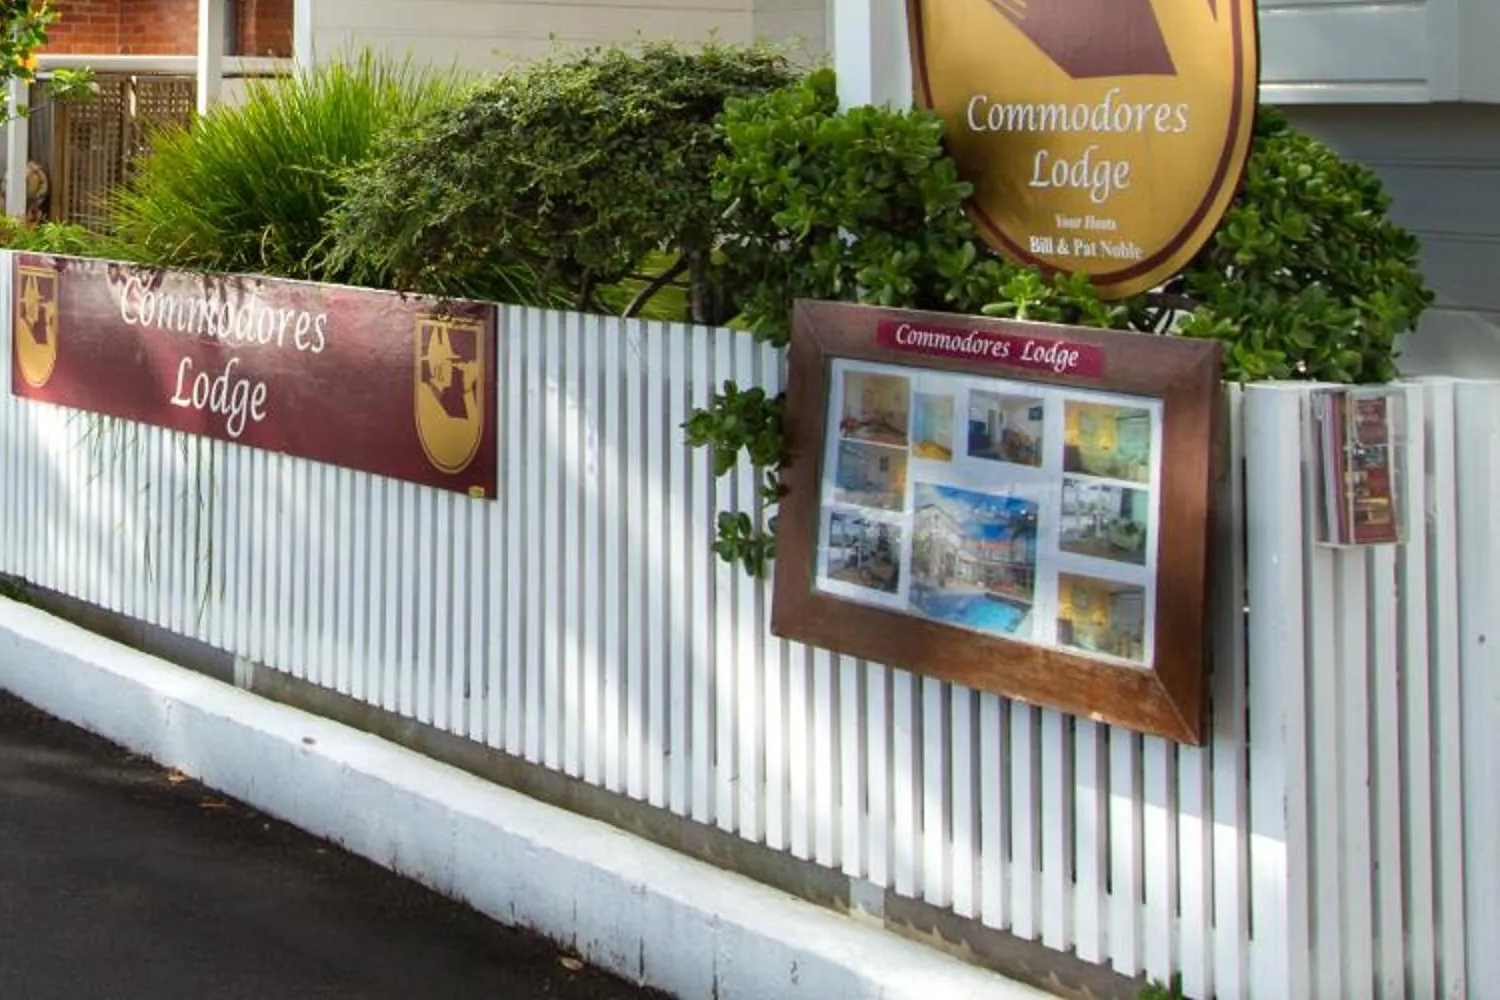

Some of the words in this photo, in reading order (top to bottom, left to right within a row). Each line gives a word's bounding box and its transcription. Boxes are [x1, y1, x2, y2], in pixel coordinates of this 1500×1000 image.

[966, 88, 1190, 134] Commodores
[1029, 145, 1132, 203] Lodge
[1028, 235, 1054, 254] Bill
[1057, 237, 1070, 255] &
[1073, 238, 1096, 256] Pat
[121, 276, 327, 353] Commodores
[895, 323, 1011, 358] Commodores
[1020, 340, 1080, 373] Lodge
[170, 357, 267, 438] Lodge
